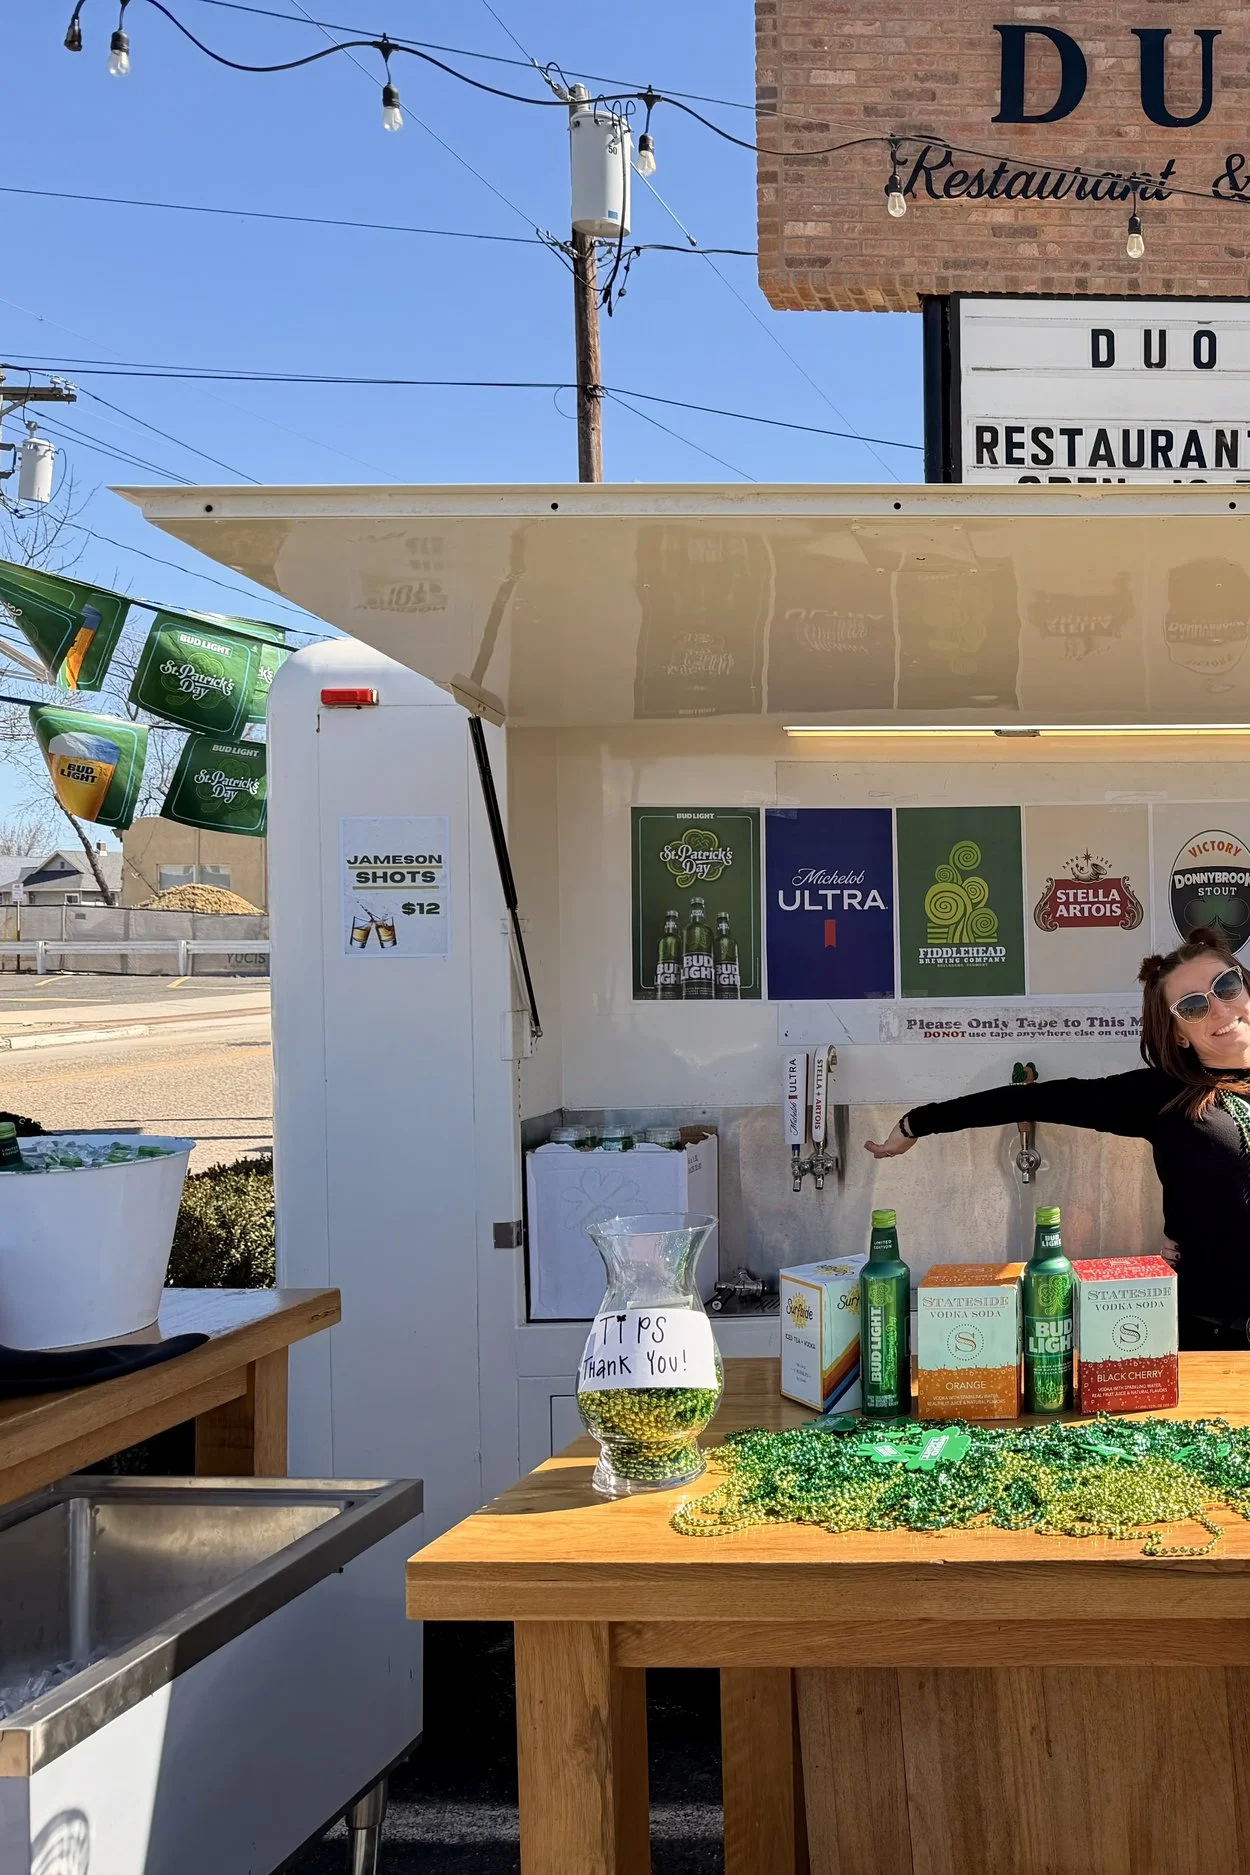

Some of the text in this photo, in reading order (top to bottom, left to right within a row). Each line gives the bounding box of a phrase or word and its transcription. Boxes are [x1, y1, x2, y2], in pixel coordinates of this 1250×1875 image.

[885, 135, 1177, 201] Restaurant
[1092, 328, 1216, 369] DUO
[180, 634, 231, 655] BUD LIGHT
[178, 678, 209, 700] Day
[212, 745, 259, 757] BUD LIGHT
[60, 768, 97, 783] LIGHT
[67, 763, 94, 774] BUD
[211, 783, 238, 804] Day
[677, 844, 733, 866] Patrick's
[1188, 840, 1242, 858] VICTORY
[346, 854, 442, 865] JAMESON
[682, 859, 711, 879] Day
[355, 871, 436, 884] SHOTS
[792, 868, 866, 886] Michelob
[1056, 888, 1121, 902] STELLA
[1198, 887, 1237, 896] STOUT
[778, 889, 886, 911] ULTRA
[401, 902, 440, 916] $12
[1056, 903, 1122, 917] ARTOIS
[919, 946, 1006, 958] FIDDLEHEAD
[684, 954, 713, 967] BUD
[906, 1018, 963, 1030] Please
[968, 1017, 1009, 1031] Only
[1016, 1017, 1058, 1030] Tape
[1063, 1017, 1081, 1028] to
[1086, 1016, 1125, 1028] This
[990, 1030, 1014, 1039] tape
[1016, 1029, 1072, 1039] anywhere
[1074, 1029, 1095, 1037] else
[1098, 1029, 1112, 1037] on
[788, 1058, 797, 1092] ULTRA
[814, 1099, 822, 1130] ARTOIS
[1041, 1239, 1062, 1247] LIGHT
[1044, 1233, 1060, 1241] BUD
[1087, 1286, 1172, 1301] STATESIDE
[922, 1296, 1009, 1308] STATESIDE
[1095, 1300, 1165, 1311] VODKA SODA
[930, 1310, 1002, 1319] VODKA SODA
[1035, 1318, 1073, 1337] BUD
[1119, 1322, 1141, 1344] S
[871, 1306, 882, 1381] BUD LIGHT
[954, 1331, 977, 1353] S
[1028, 1336, 1073, 1354] LIGH
[1096, 1369, 1164, 1383] BLACK CHERRY
[945, 1380, 987, 1391] ORANGE
